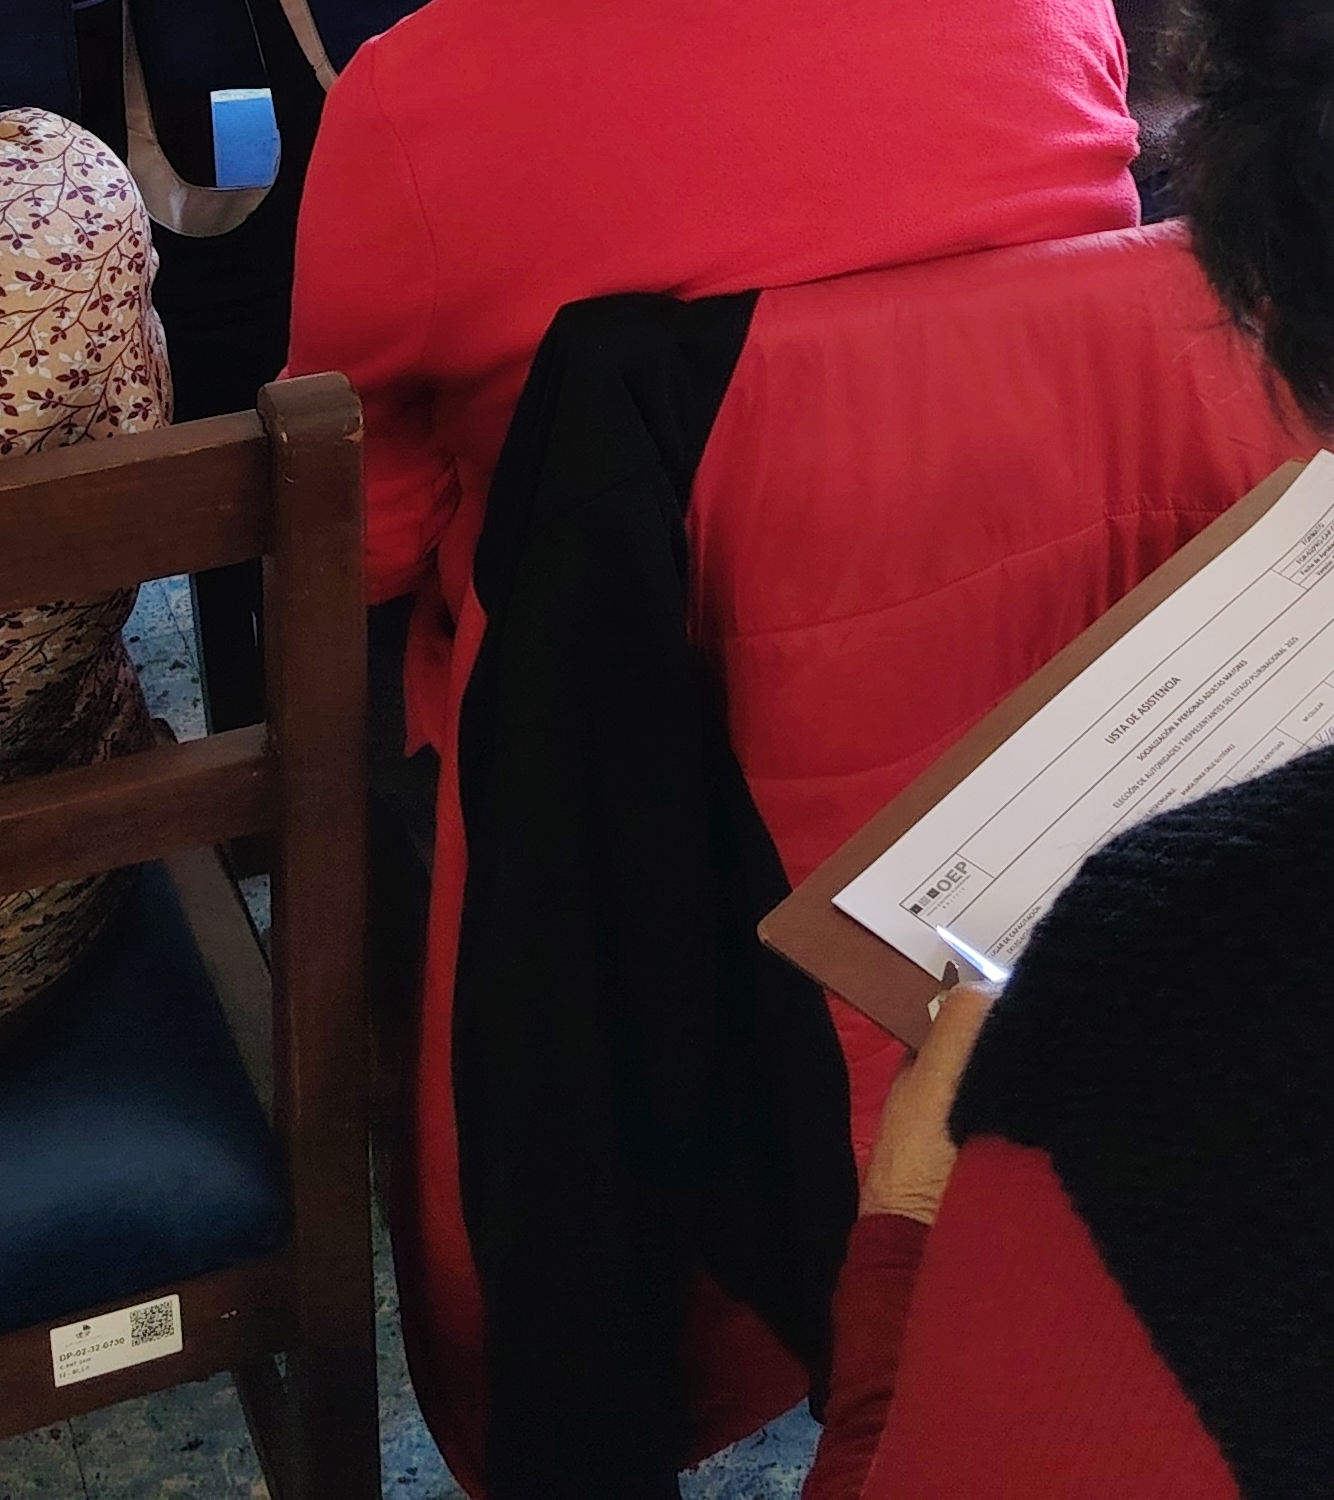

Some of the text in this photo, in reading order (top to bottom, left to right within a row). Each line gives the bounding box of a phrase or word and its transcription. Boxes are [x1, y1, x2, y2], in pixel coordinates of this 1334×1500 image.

[1103, 674, 1182, 744] LISTA DE ASISTENCIA
[1110, 783, 1141, 808] ELECCIÓN
[1135, 776, 1148, 786] DE
[1143, 744, 1183, 778] AUTORIDADES
[1181, 703, 1226, 743] REPRESENTANTES
[1221, 694, 1235, 705] DEL
[1230, 678, 1253, 697] ESTADO
[1247, 646, 1288, 681] PLURINACIONAL
[1134, 724, 1177, 761] SOCIALIZACIÓN
[1176, 698, 1206, 722] PERSONAS
[1201, 678, 1227, 700] ADULTAS
[1221, 658, 1249, 681] MAYORES
[933, 860, 972, 892] OEP
